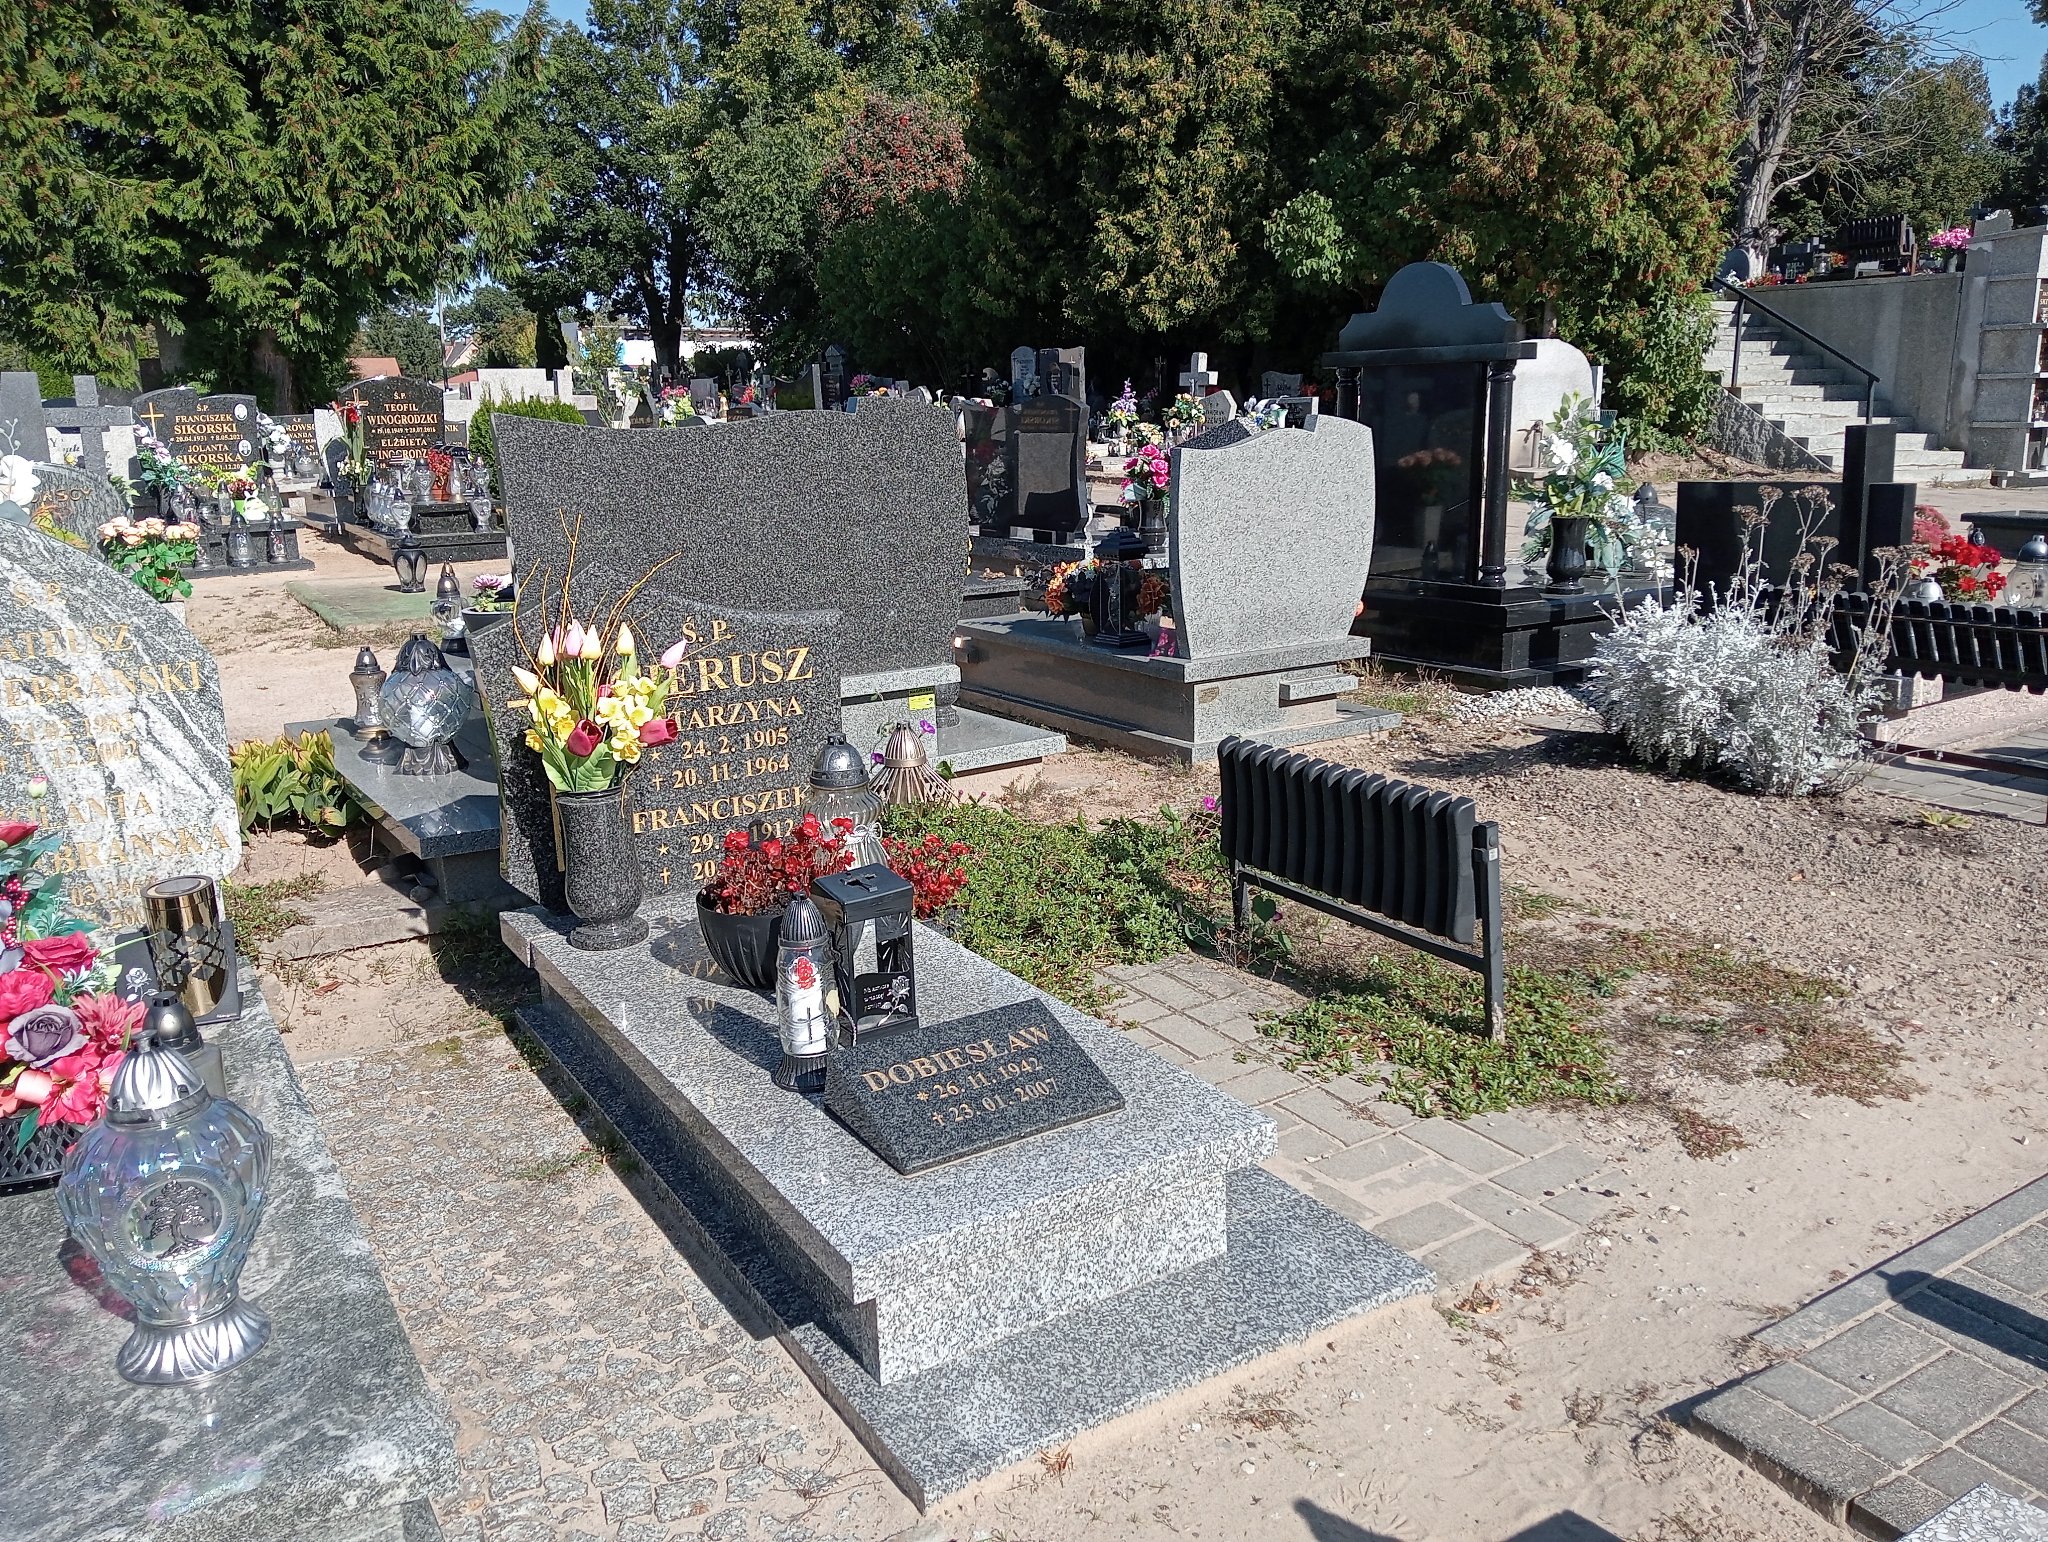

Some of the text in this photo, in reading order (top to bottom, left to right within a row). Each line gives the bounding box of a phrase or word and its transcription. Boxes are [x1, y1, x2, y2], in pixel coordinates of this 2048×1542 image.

[175, 413, 233, 423] FRANCISZEK
[367, 413, 438, 425] WINOGRODZKI
[384, 403, 419, 412] TEOFIL
[174, 423, 237, 435] SIKORSKI
[381, 437, 428, 447] ELŻBIETA
[176, 453, 243, 464] SIKORSKA
[187, 443, 229, 452] JOLANTA
[612, 646, 814, 696] IERUSZ
[664, 695, 805, 732] TARZYNA
[681, 726, 790, 760] 24. 2. 1905
[672, 752, 790, 789] 20. 11. 1964
[0, 790, 155, 831] OLANTA
[632, 785, 811, 834] FRANCISZEK
[53, 822, 230, 874] BRAŃSKA
[689, 833, 720, 854] 29.
[860, 1024, 1051, 1093] DOBIESŁAW
[933, 1057, 1044, 1100] 26. 11. 1942
[948, 1077, 1060, 1122] 23. 01. 2007
